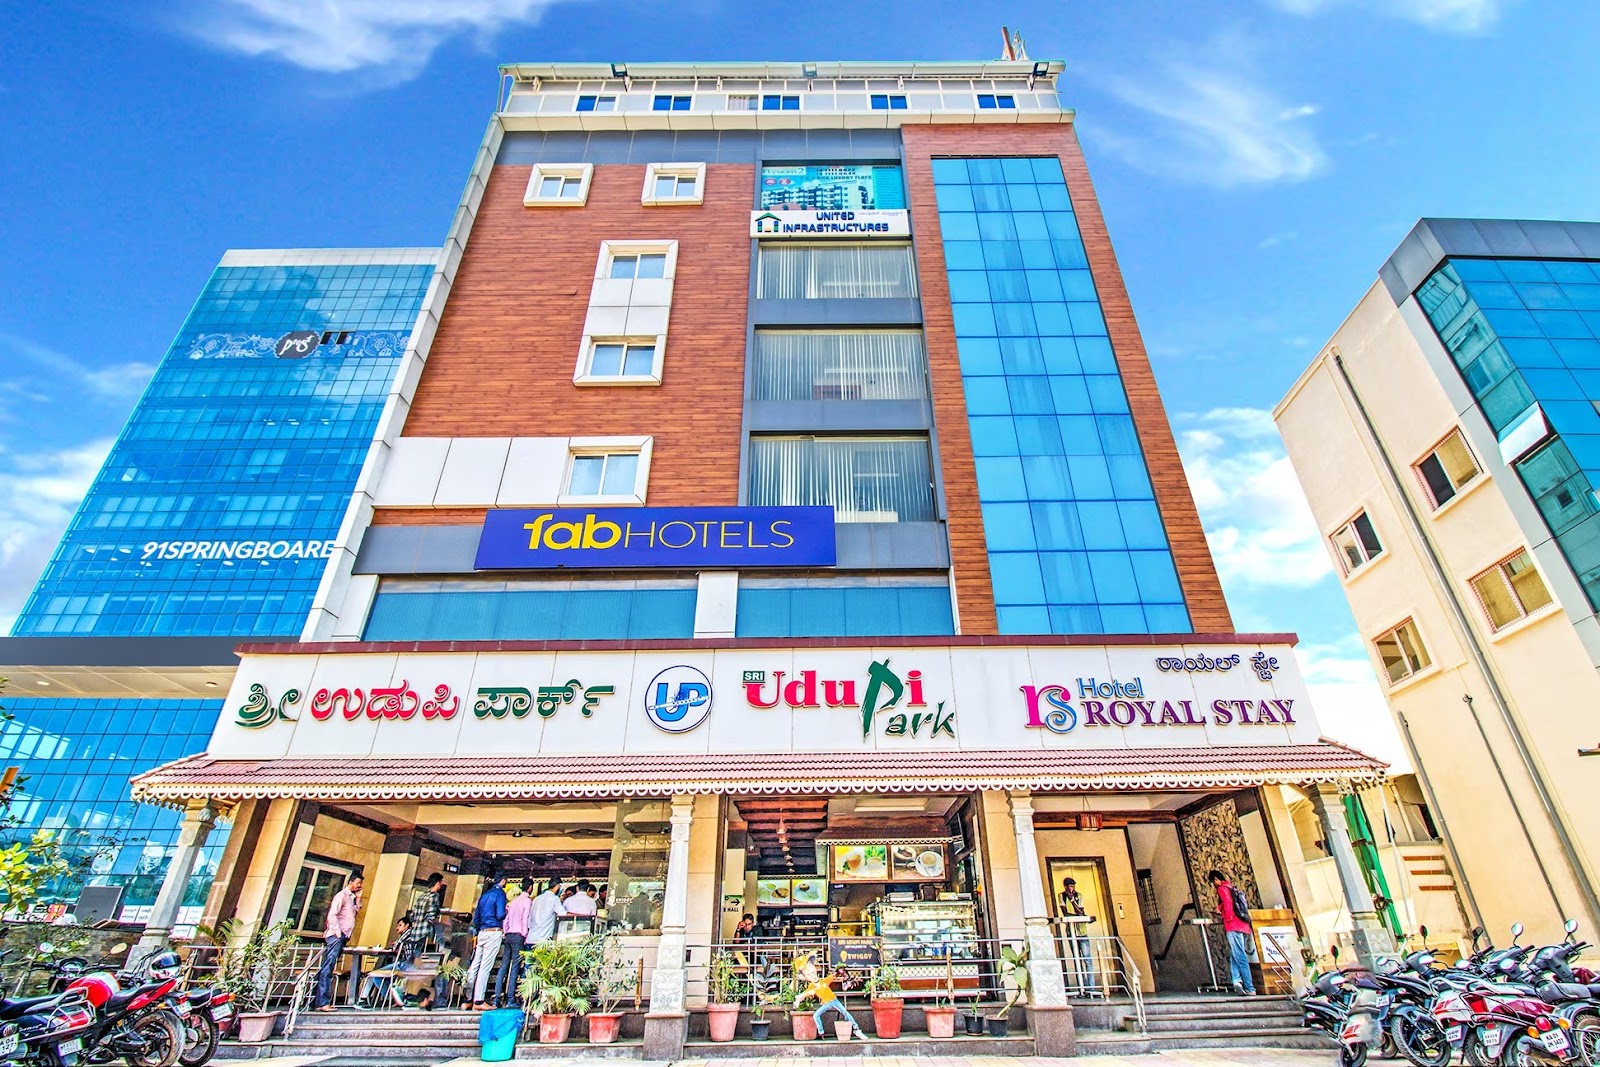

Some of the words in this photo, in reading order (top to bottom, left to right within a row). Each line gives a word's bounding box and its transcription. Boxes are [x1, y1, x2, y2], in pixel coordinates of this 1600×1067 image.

[816, 211, 855, 221] UNITED
[783, 223, 889, 233] INFRASTRUCTURES
[1156, 652, 1240, 672] ರಾಯಲ್
[744, 671, 765, 682] SRI
[1076, 677, 1145, 698] Hotel
[234, 682, 302, 728] ಶ್ರೀ
[310, 680, 459, 721] ಉಡುಪಿ
[473, 679, 615, 719] ಪಾರ್ಕ್
[1081, 700, 1206, 726] ROYAL
[1213, 699, 1297, 725] STAY
